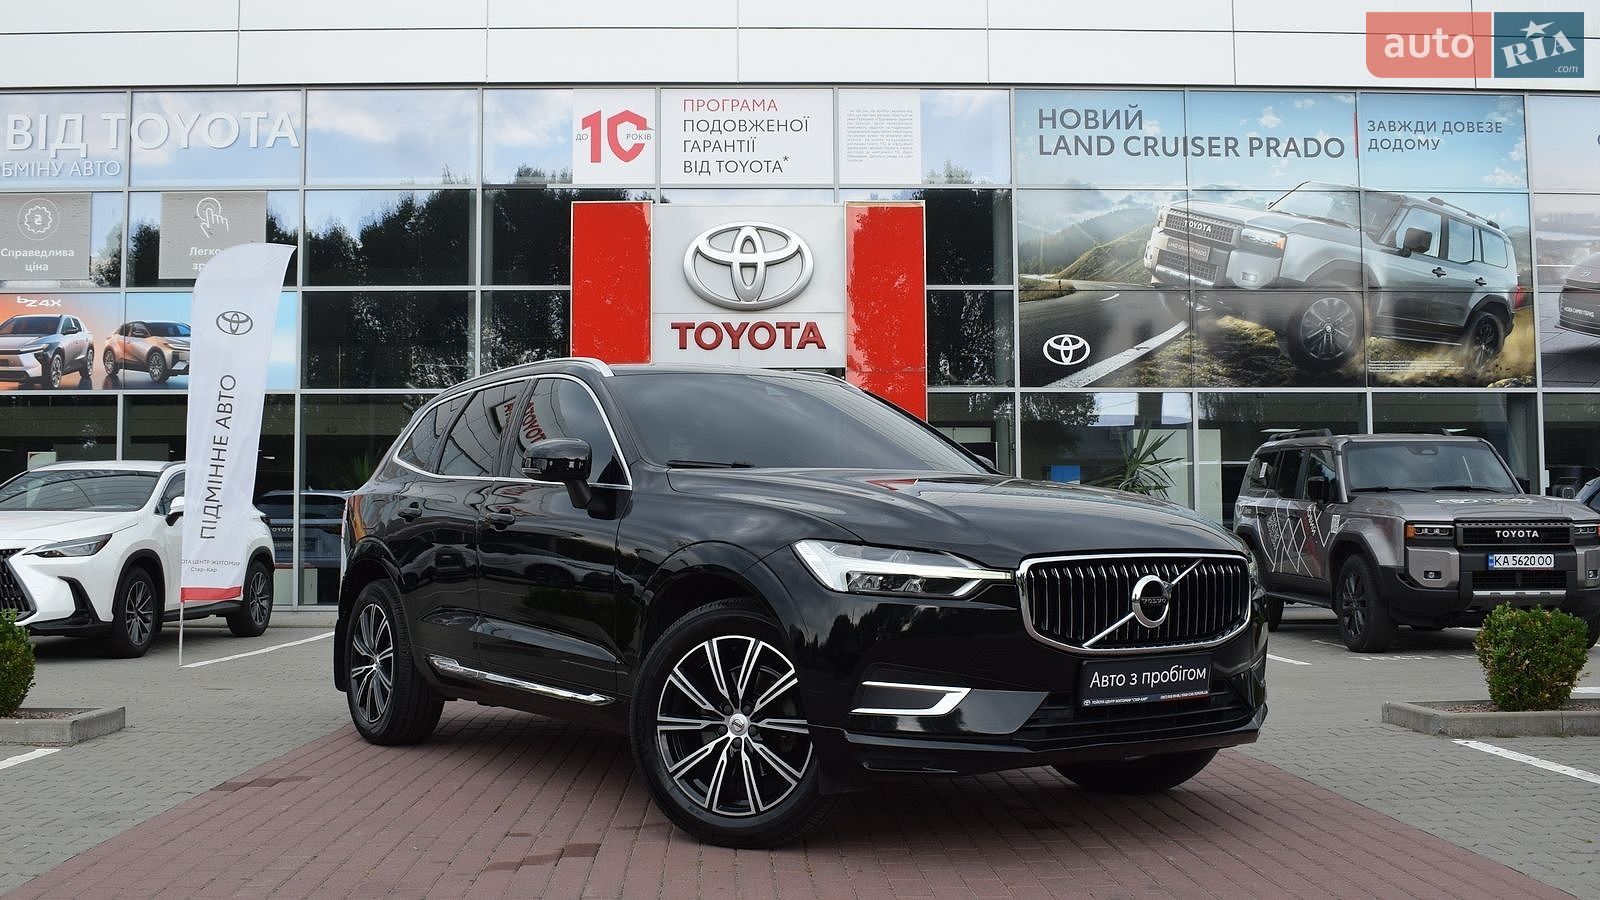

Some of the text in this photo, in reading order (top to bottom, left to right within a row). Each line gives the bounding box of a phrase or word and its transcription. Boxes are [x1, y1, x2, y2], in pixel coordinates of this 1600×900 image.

[683, 99, 778, 112] ПРОГРАМА
[683, 115, 810, 134] ПОДОВЖЕНОЇ
[1038, 104, 1143, 131] НОВИЙ
[6, 112, 300, 158] ВІД TOYOTA
[1367, 120, 1503, 135] ЗАВЖДИ ДОВЕЗЕ
[576, 133, 589, 141] ДО
[626, 133, 653, 141] РОКІВ
[683, 136, 757, 153] ГАРАНТІЇ
[1368, 137, 1441, 153] ДОДОМУ
[1038, 135, 1346, 159] LAND CRUISER PRADO
[70, 160, 122, 177] АВТО
[683, 161, 711, 176] ВІД
[0, 247, 75, 259] Справедлива
[25, 262, 49, 273] ціна
[671, 321, 826, 350] TOYOTA
[200, 374, 237, 540] ПІДМІННЕ АВТО
[1495, 530, 1540, 539] TOYOTA
[1494, 555, 1510, 566] KA
[1512, 556, 1535, 566] 5620
[1090, 665, 1206, 688] Авто з пробігом
